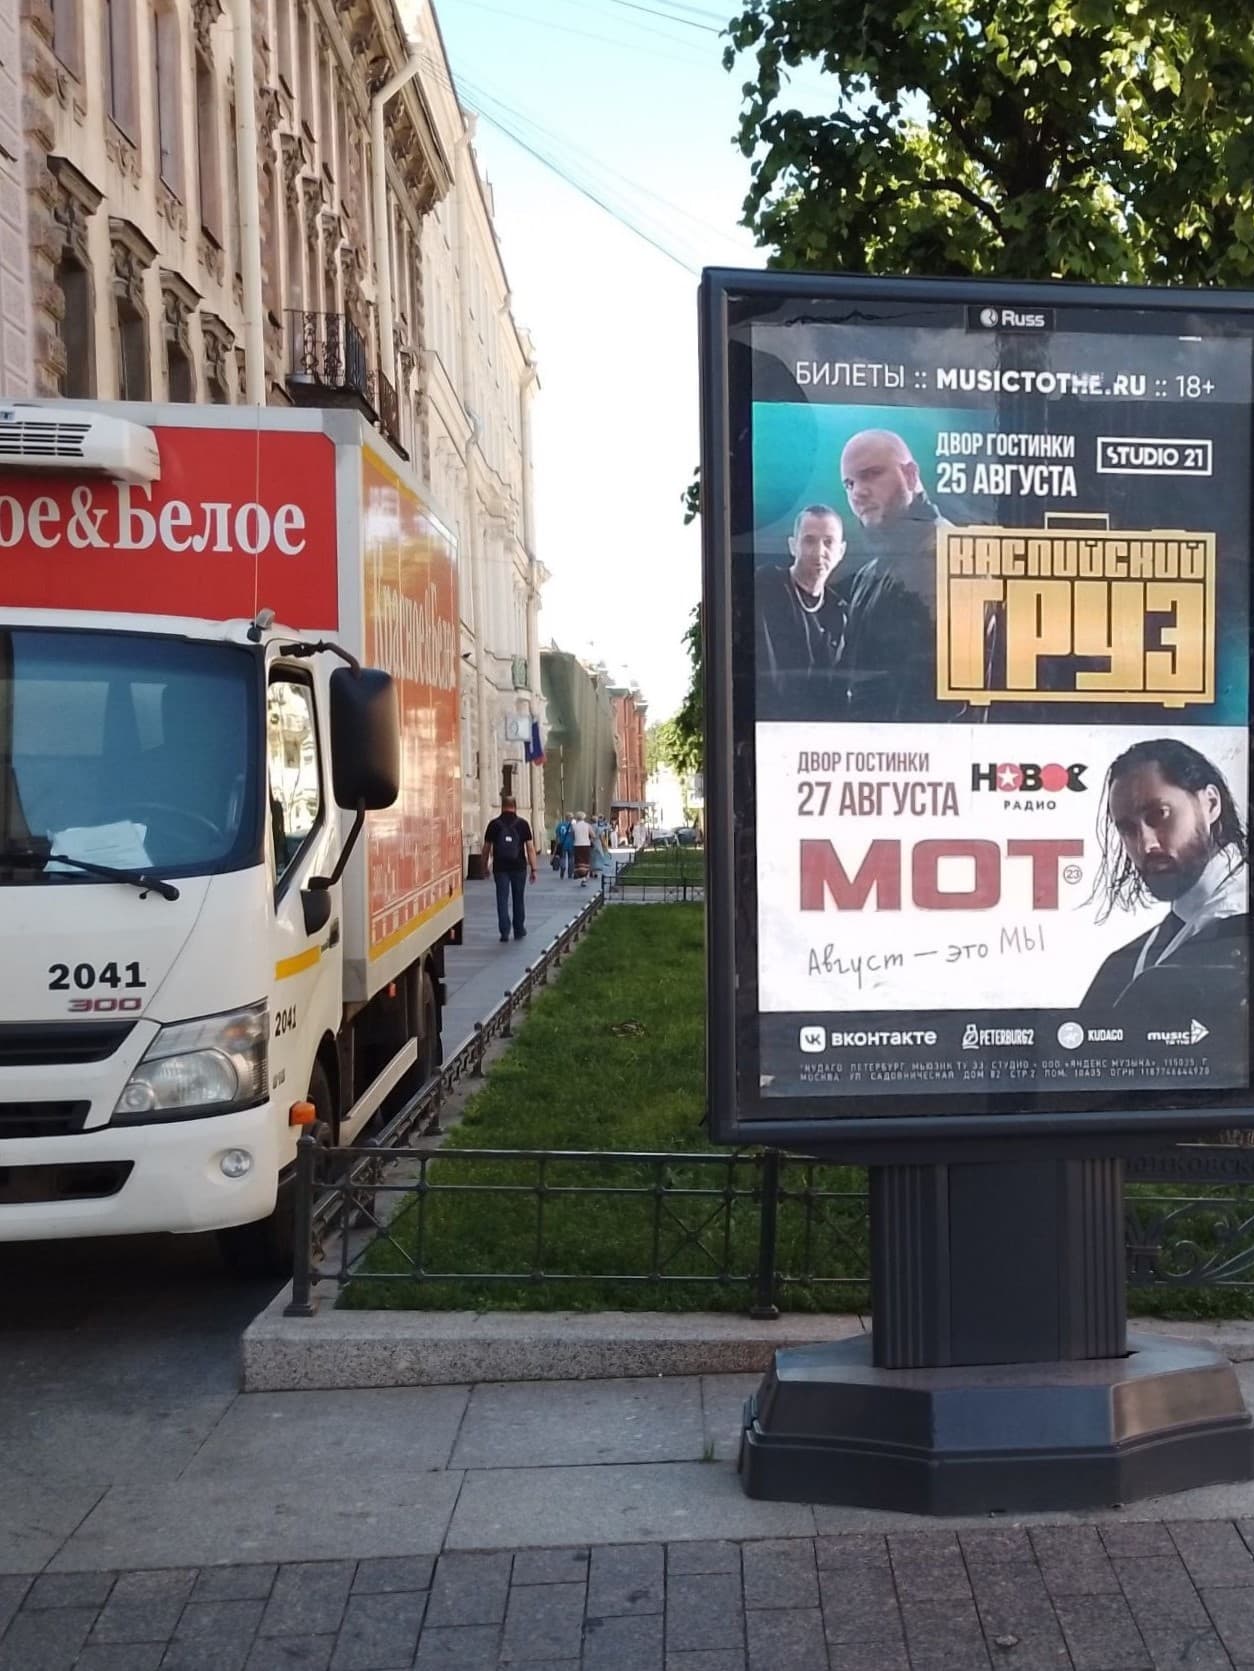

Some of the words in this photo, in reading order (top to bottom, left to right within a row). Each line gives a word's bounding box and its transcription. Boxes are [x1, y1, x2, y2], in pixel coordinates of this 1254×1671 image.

[1001, 310, 1045, 327] Russ
[796, 361, 905, 388] БИЛЕТЫ
[936, 367, 1146, 396] MUSICTOTHE.RU
[1175, 375, 1215, 398] 18+
[935, 432, 983, 457] ДВОР
[986, 433, 1075, 458] ГОСТИНКИ
[1107, 447, 1179, 466] STUDIO
[1184, 448, 1203, 467] 21
[936, 463, 967, 494] 25
[972, 463, 1078, 497] АВГУСТА
[949, 536, 1206, 580] КАСПИЙСКИЙ
[949, 578, 1204, 691] ГРУЗ
[797, 752, 841, 774] ДВОР
[846, 752, 930, 773] ГОСТИНКИ
[798, 781, 832, 816] 27
[838, 781, 960, 817] АВГУСТА
[1003, 800, 1057, 812] РАДИО
[799, 838, 1085, 913] МОТ
[807, 942, 904, 990] Август
[945, 942, 989, 963] это
[1000, 924, 1045, 955] МЫ
[48, 961, 147, 991] 2041
[67, 997, 142, 1013] 300
[274, 1004, 297, 1037] 2041
[1087, 1028, 1124, 1042] KUDAGO
